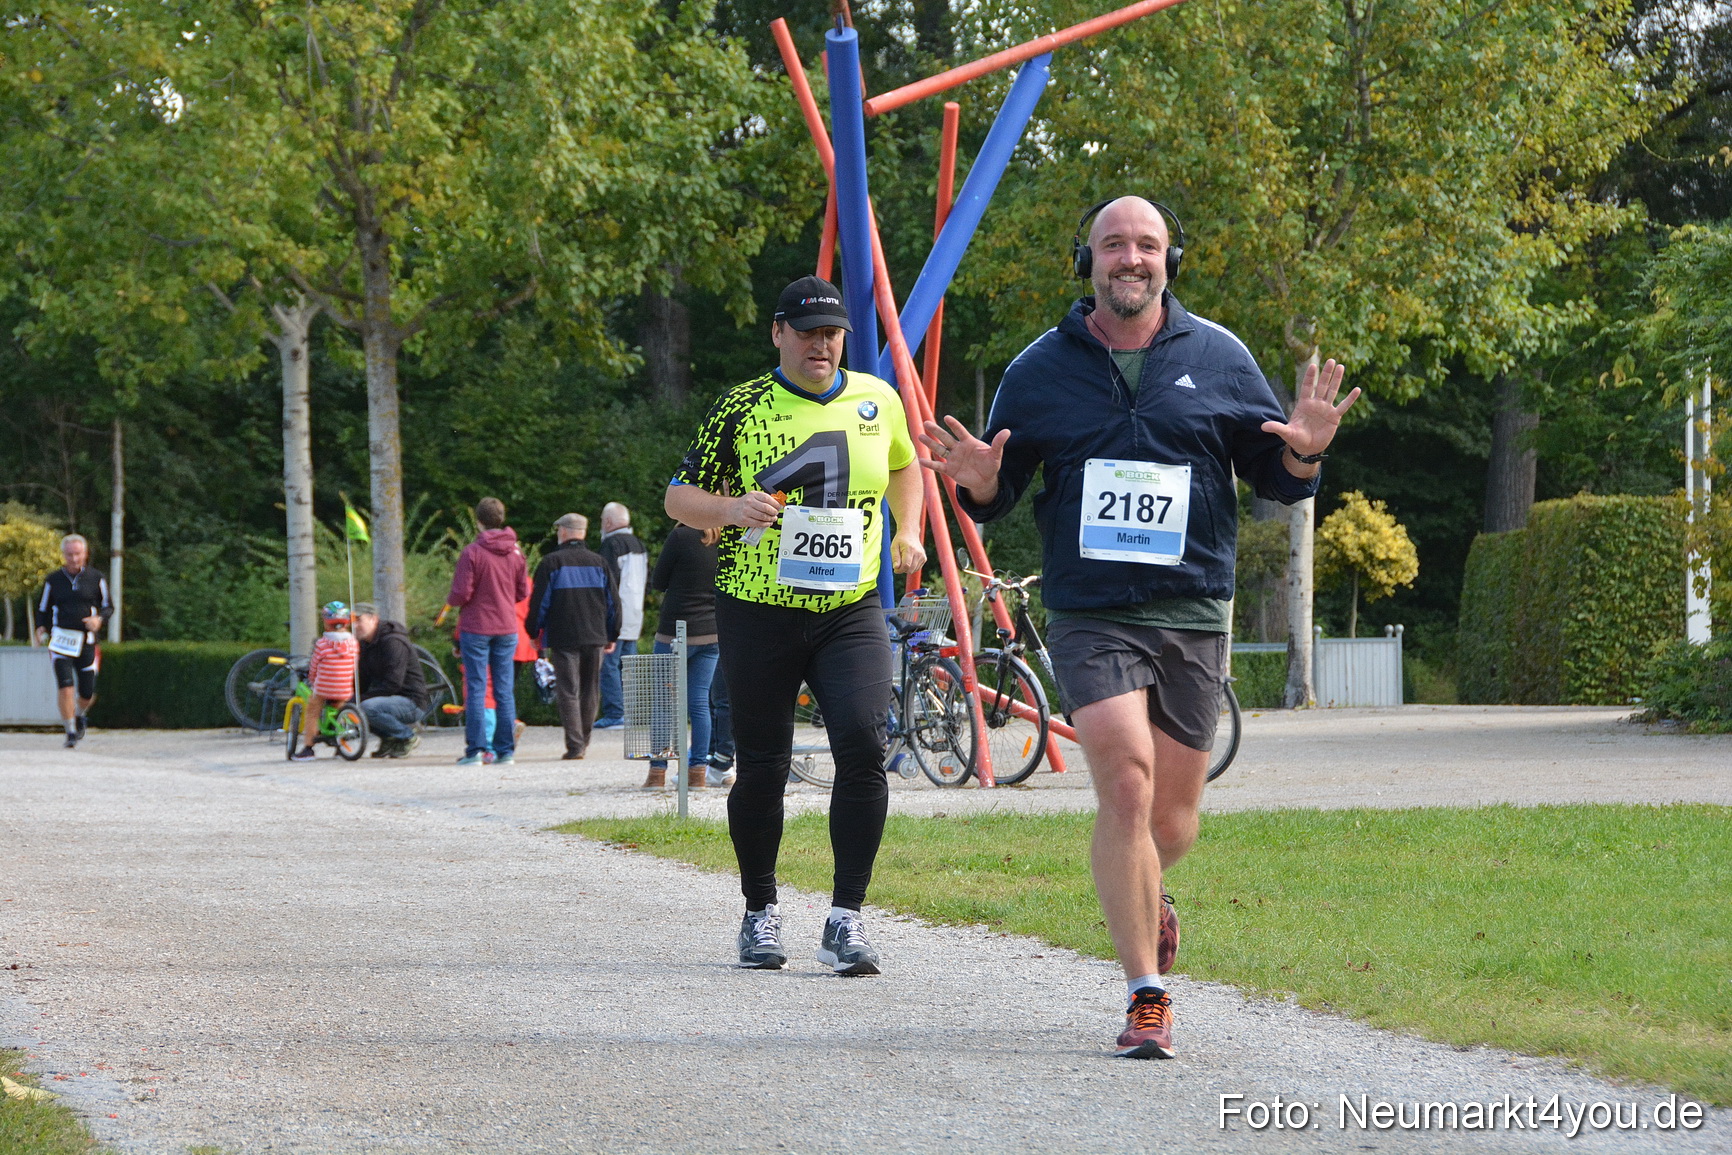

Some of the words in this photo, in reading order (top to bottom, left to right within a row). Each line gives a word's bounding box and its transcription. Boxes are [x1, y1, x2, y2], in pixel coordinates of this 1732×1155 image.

[1125, 470, 1161, 481] BOCK
[1098, 491, 1173, 525] 2187
[1117, 532, 1151, 545] Martin
[793, 532, 852, 559] 2665
[808, 566, 835, 576] Alfred
